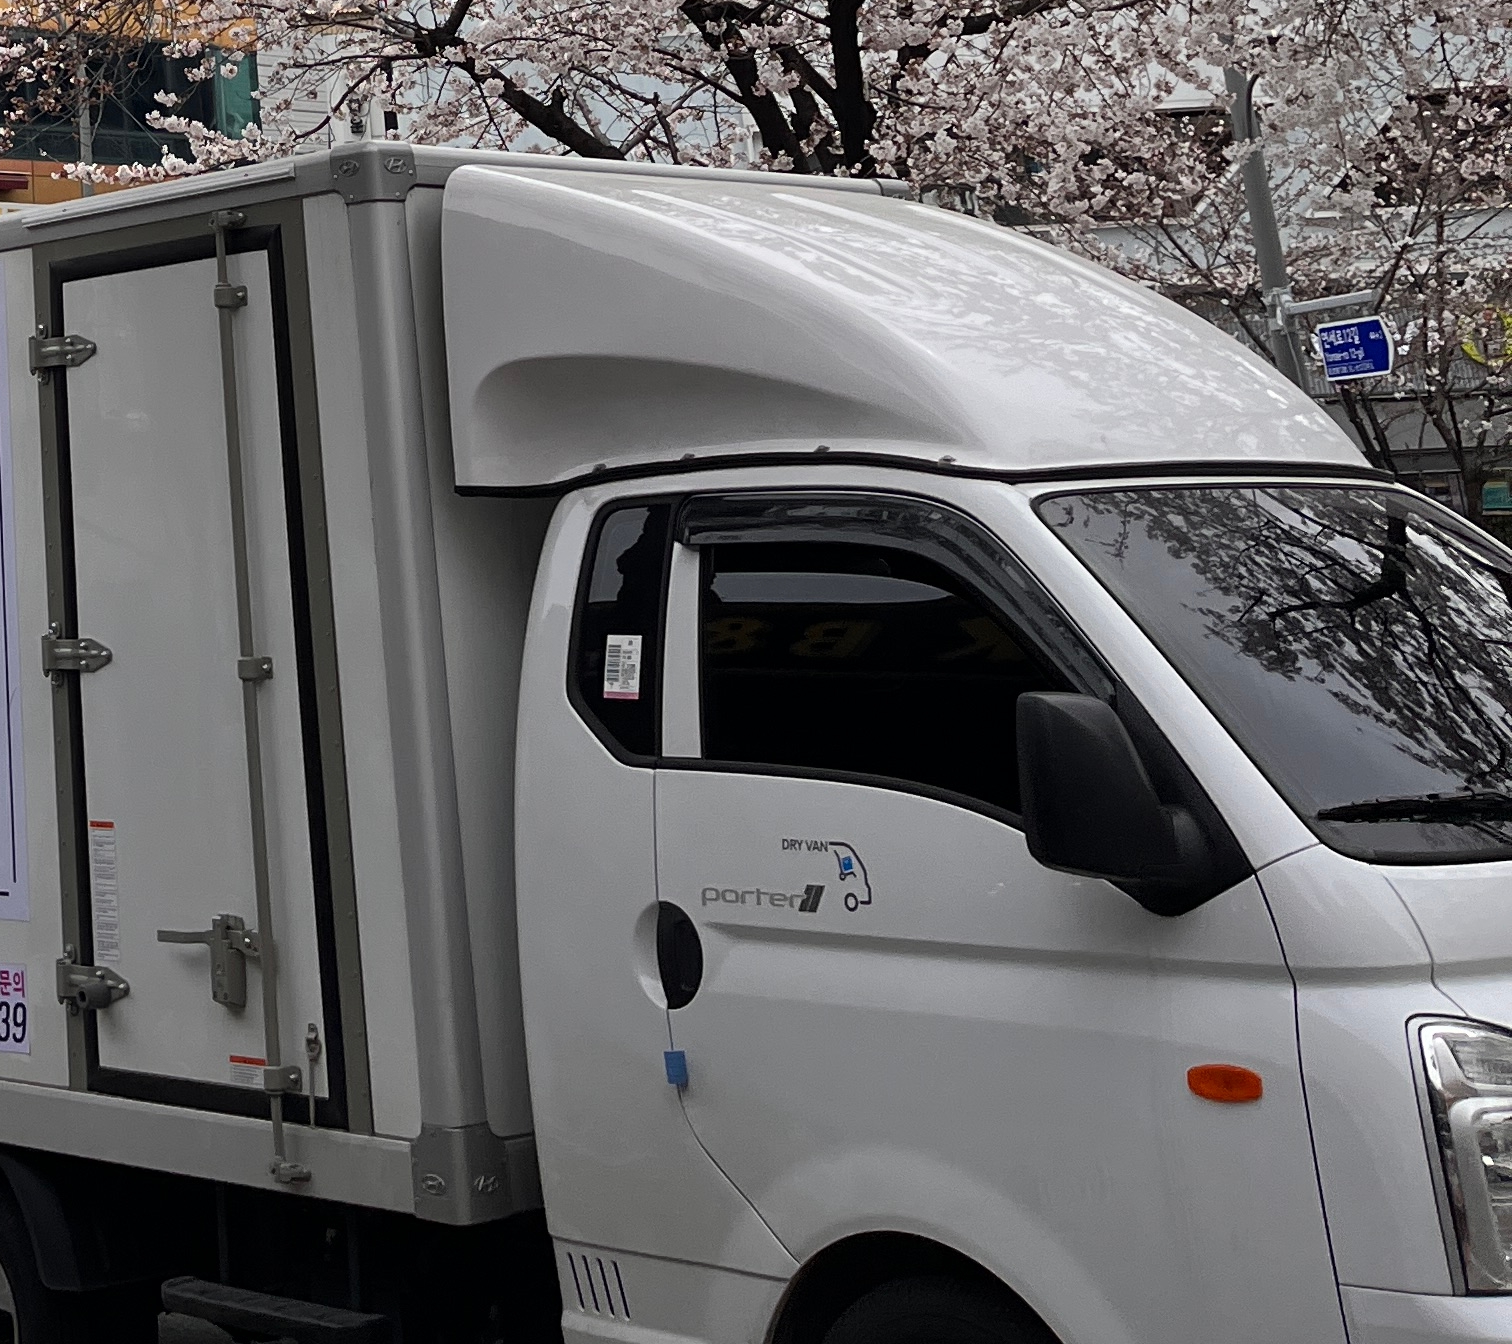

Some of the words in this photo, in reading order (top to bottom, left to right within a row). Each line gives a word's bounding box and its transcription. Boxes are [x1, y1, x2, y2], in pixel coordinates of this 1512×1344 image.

[781, 838, 803, 851] DRY
[804, 839, 829, 852] VAN
[701, 886, 806, 908] porter
